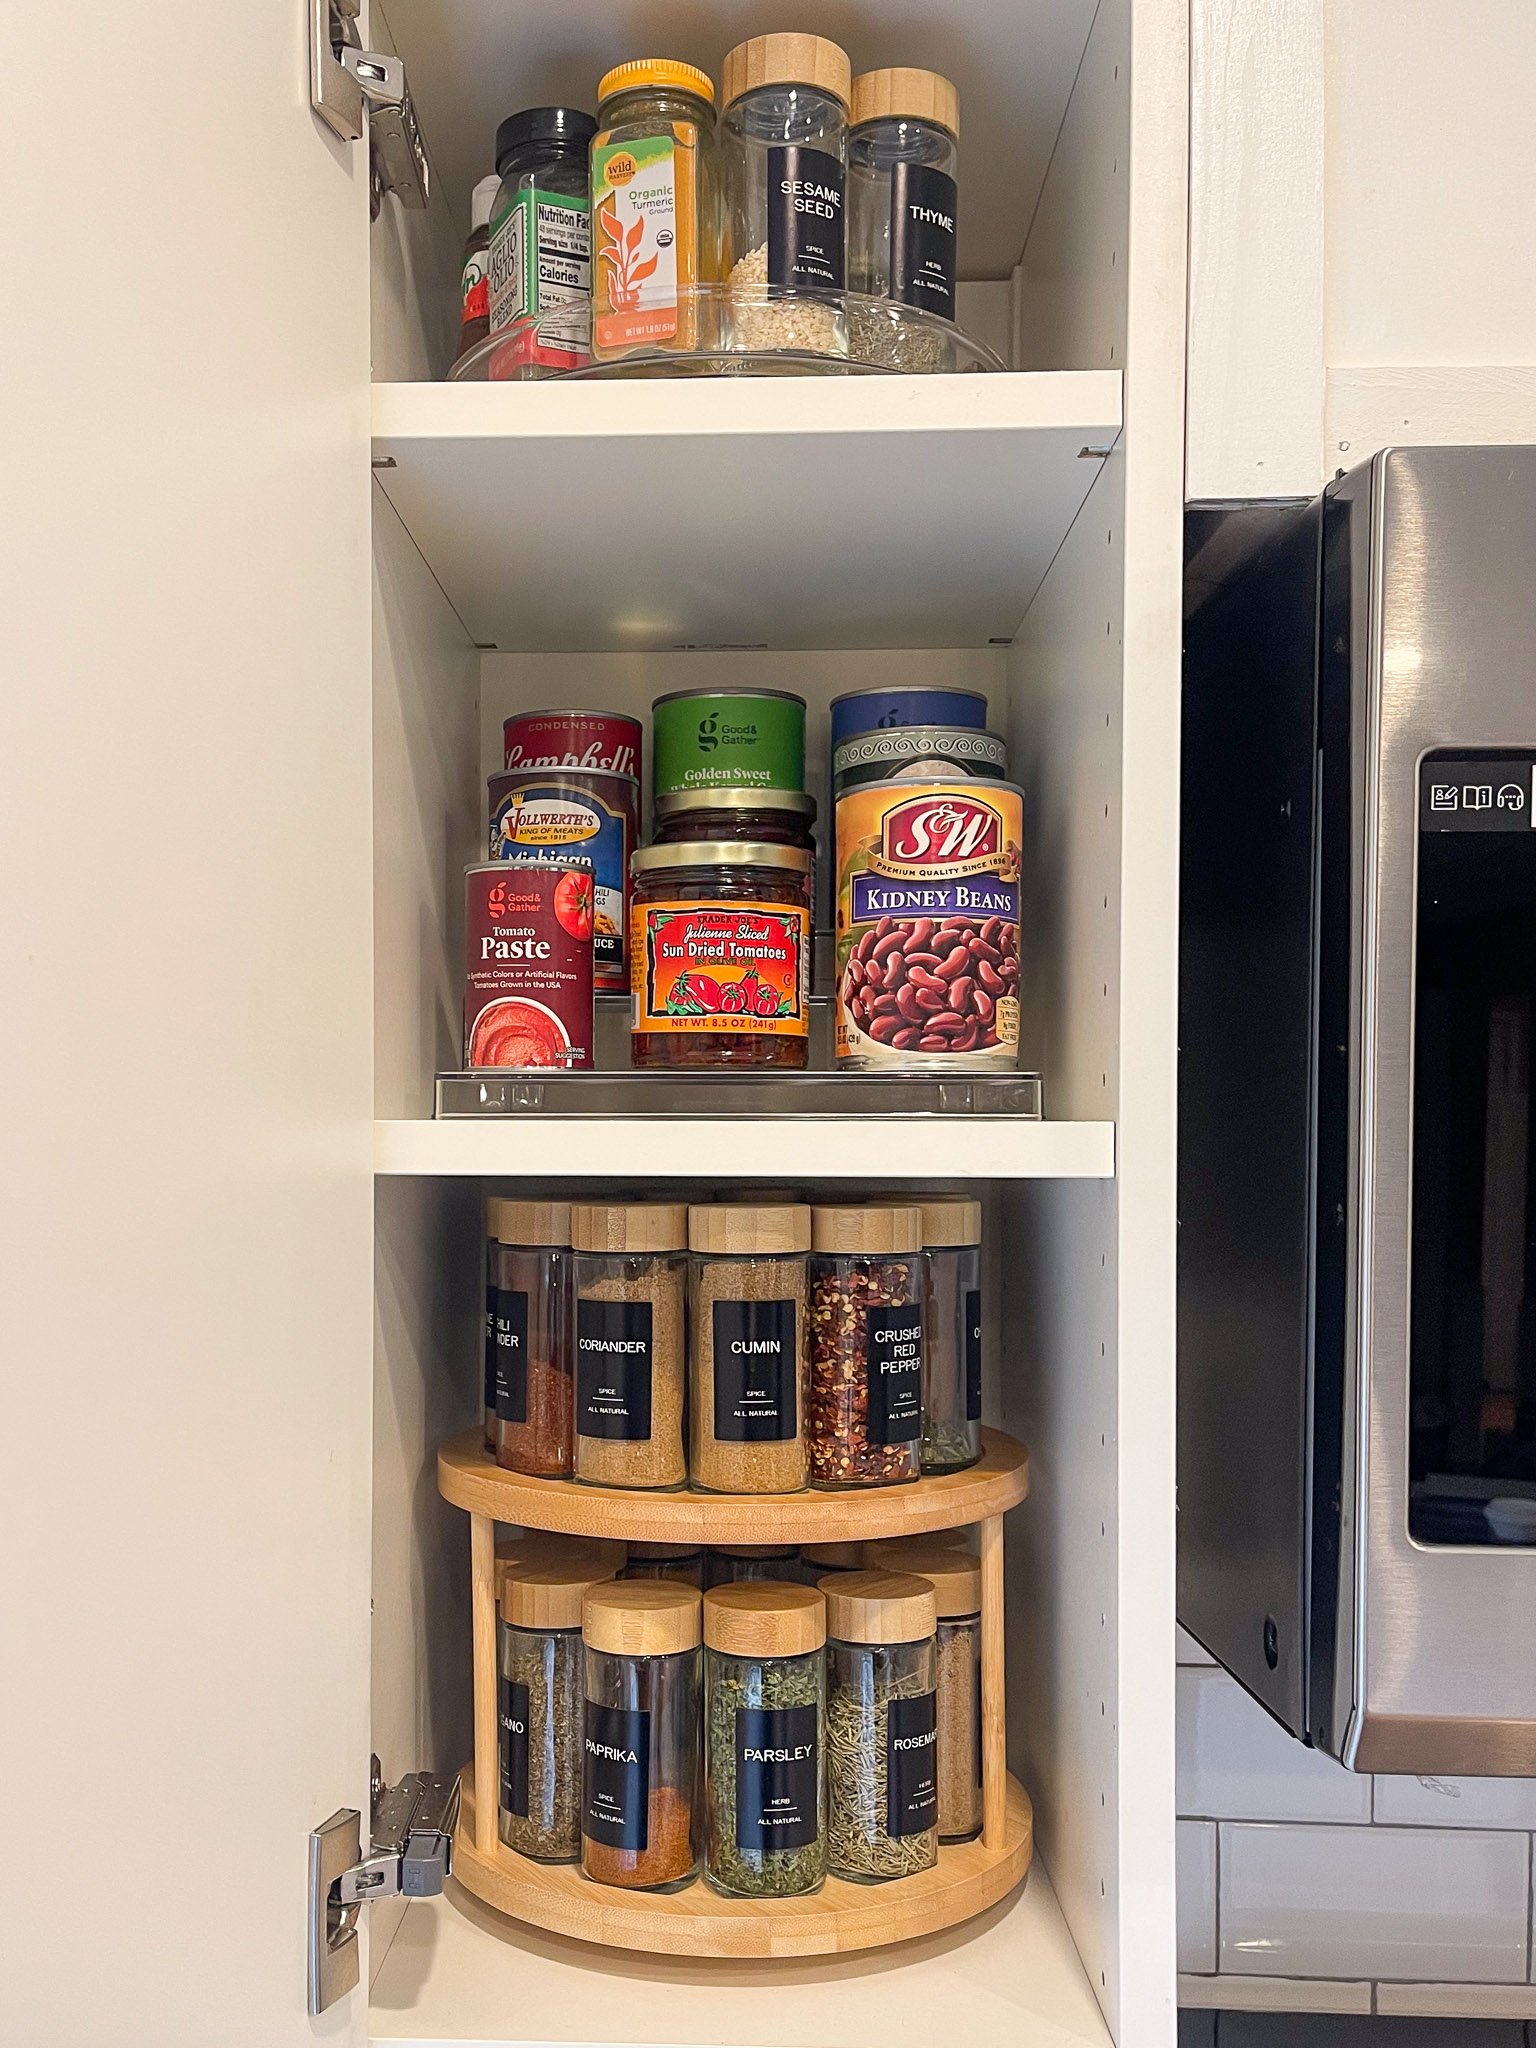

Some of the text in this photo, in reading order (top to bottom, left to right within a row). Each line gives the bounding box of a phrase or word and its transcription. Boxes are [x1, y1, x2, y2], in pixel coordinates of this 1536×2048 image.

[608, 161, 632, 174] wild
[629, 187, 673, 200] Organic
[780, 180, 841, 208] SESAME
[632, 198, 673, 210] Turmeric
[794, 198, 835, 219] SEED
[538, 204, 575, 227] Nutrition
[909, 205, 954, 234] THYME
[539, 235, 558, 248] Serving
[805, 245, 824, 255] SPICE
[493, 255, 515, 294] OLIO
[539, 265, 579, 284] Calories
[792, 265, 834, 280] ALL NATURAL
[912, 279, 926, 287] ALL
[528, 721, 605, 732] CONDENSED
[721, 735, 757, 745] Gather
[684, 767, 772, 781] Golden Sweet
[505, 807, 594, 840] VOLLWERTH'S
[553, 827, 584, 835] MEATS
[895, 803, 993, 859] S&W
[876, 862, 916, 877] PREMIUM
[919, 868, 960, 877] QUALITY
[962, 861, 987, 873] SINCE
[507, 893, 542, 903] Good&
[867, 886, 1013, 912] KIDNEY BEANS
[507, 903, 542, 912] Gather
[696, 915, 760, 925] TRADER JOE'S
[492, 926, 537, 937] Tomato
[684, 924, 770, 943] Julienne Sliced
[480, 937, 552, 960] Paste
[662, 941, 787, 960] Sun Dried Tomatoes
[492, 970, 515, 979] Colors
[515, 971, 524, 979] or
[524, 970, 555, 979] Artificial
[555, 971, 577, 980] Flavors
[474, 980, 561, 989] Tomatoes Grown in the USA
[672, 1019, 778, 1031] NET WT. 8.5 OZ (241g)
[554, 1052, 586, 1060] SUGGESTION
[579, 1338, 646, 1354] CORIANDER
[730, 1340, 781, 1355] CUMIN
[893, 1343, 916, 1358] RED
[598, 1388, 617, 1396] SPICE
[746, 1390, 767, 1398] SPICE
[899, 1391, 913, 1400] SPICE
[587, 1406, 630, 1416] ALL NATURAL
[733, 1409, 779, 1418] ALL NATURAL
[888, 1412, 900, 1421] ALL
[585, 1738, 638, 1764] PAPRIKA
[744, 1743, 813, 1763] PARSLEY
[598, 1793, 615, 1803] SPICE
[771, 1798, 791, 1806] HERB
[908, 1803, 920, 1811] ALL
[589, 1809, 626, 1826] ALL NATURAL
[757, 1816, 802, 1826] ALL NATURAL
